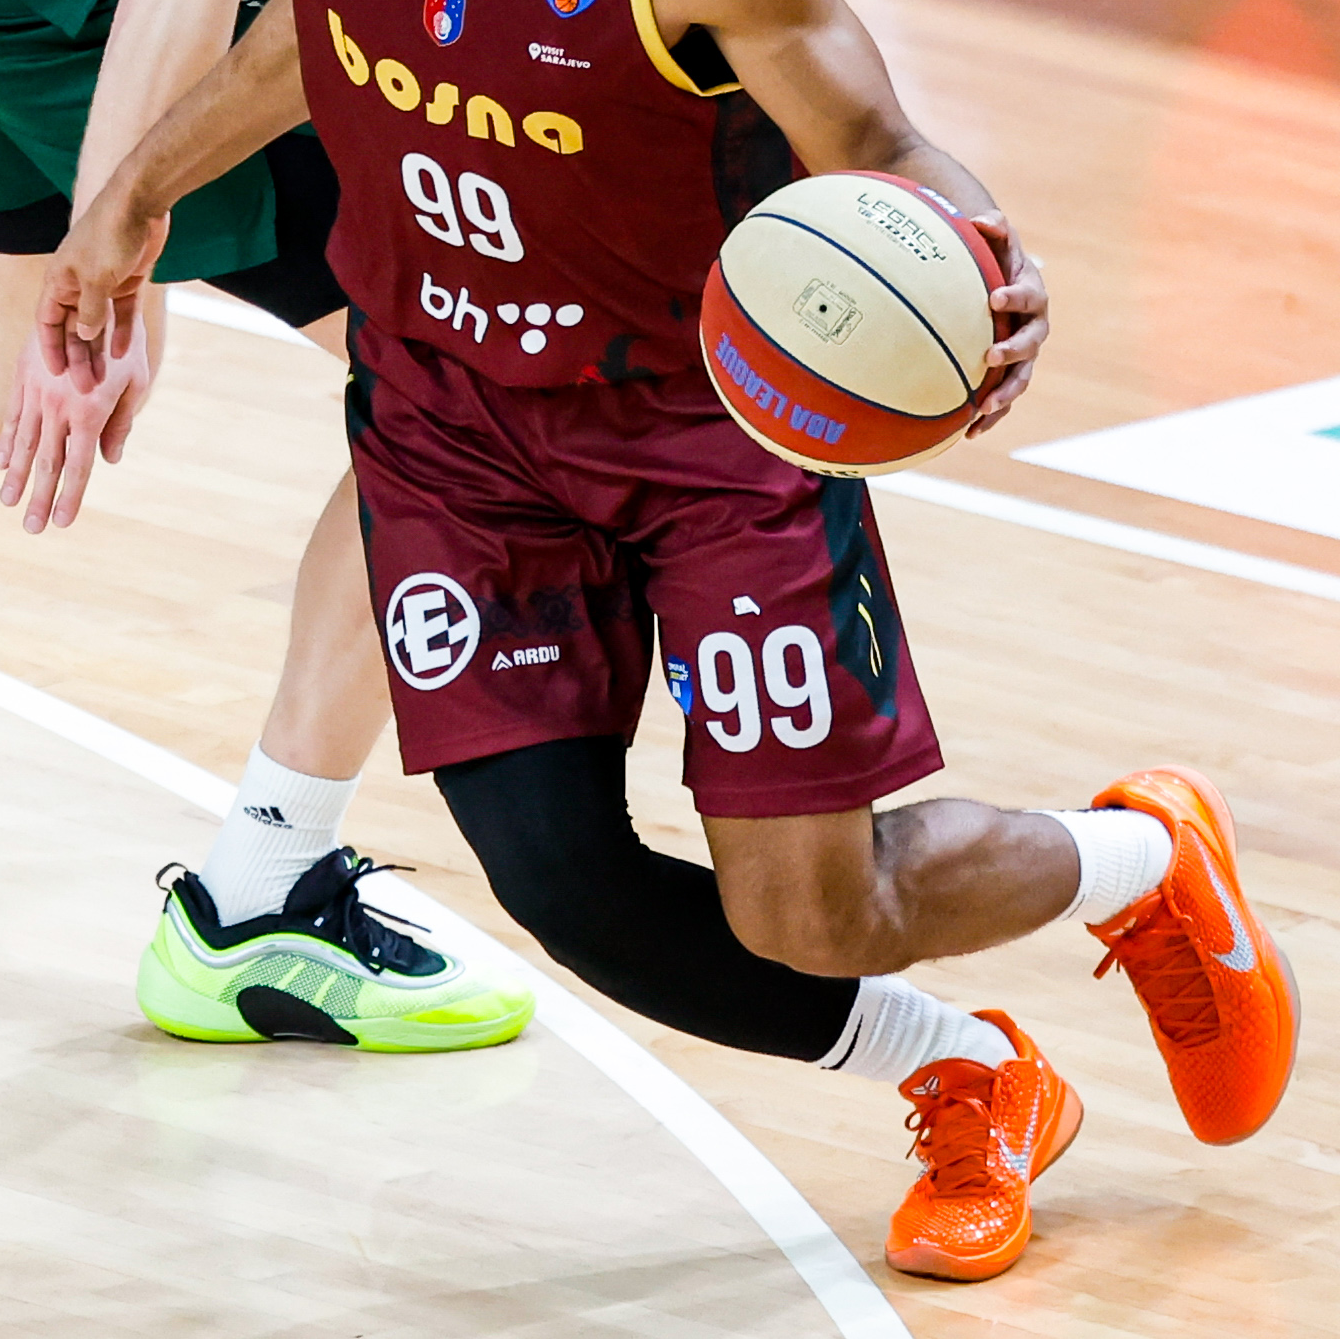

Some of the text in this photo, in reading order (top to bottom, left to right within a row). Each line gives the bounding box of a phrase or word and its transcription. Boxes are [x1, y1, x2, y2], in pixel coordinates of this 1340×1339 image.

[327, 8, 584, 155] bosna
[540, 54, 591, 69] SARAJEVO
[541, 45, 565, 57] VISIT
[401, 152, 525, 262] 99
[857, 193, 947, 261] LEGACY
[420, 272, 489, 344] bh
[715, 332, 847, 444] ABA LEAGUE
[513, 645, 560, 666] ARDU
[697, 625, 833, 753] 99
